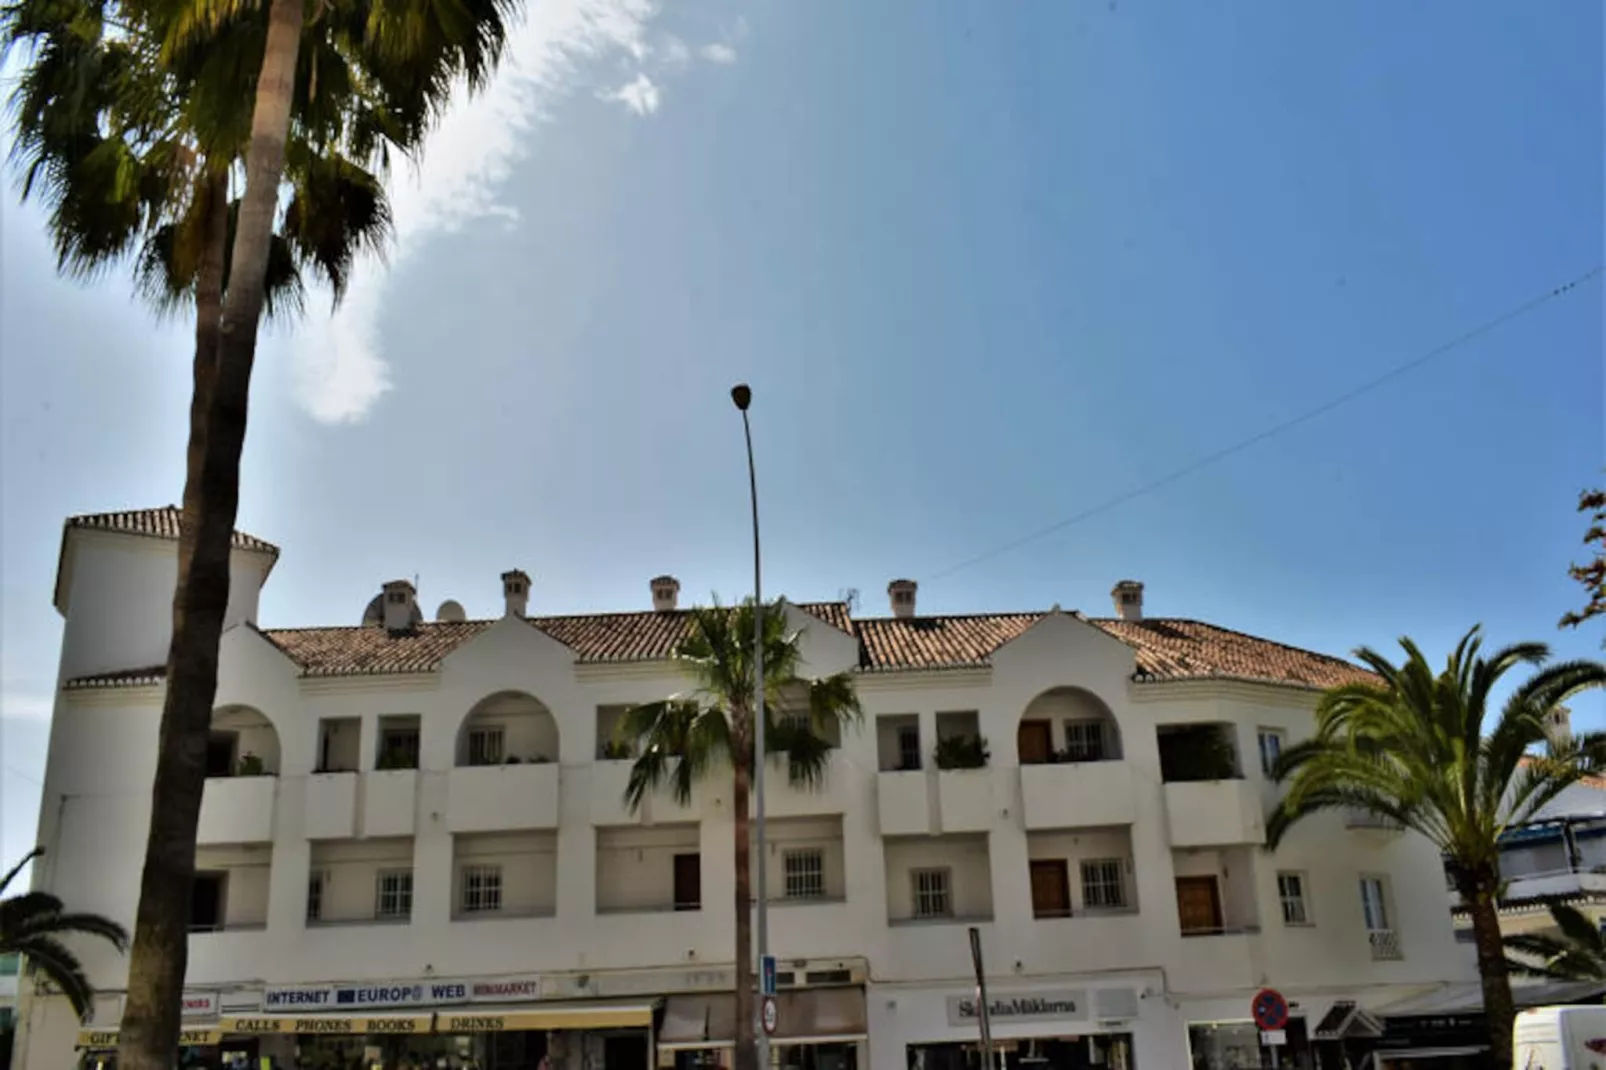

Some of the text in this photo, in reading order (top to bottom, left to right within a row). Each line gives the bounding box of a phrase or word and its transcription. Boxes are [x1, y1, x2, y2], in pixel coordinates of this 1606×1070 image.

[266, 990, 330, 1005] INTERNET
[431, 984, 466, 998] WEB
[236, 1017, 416, 1031] CALLS PHONES BOOKS
[451, 1017, 504, 1030] DRINKS
